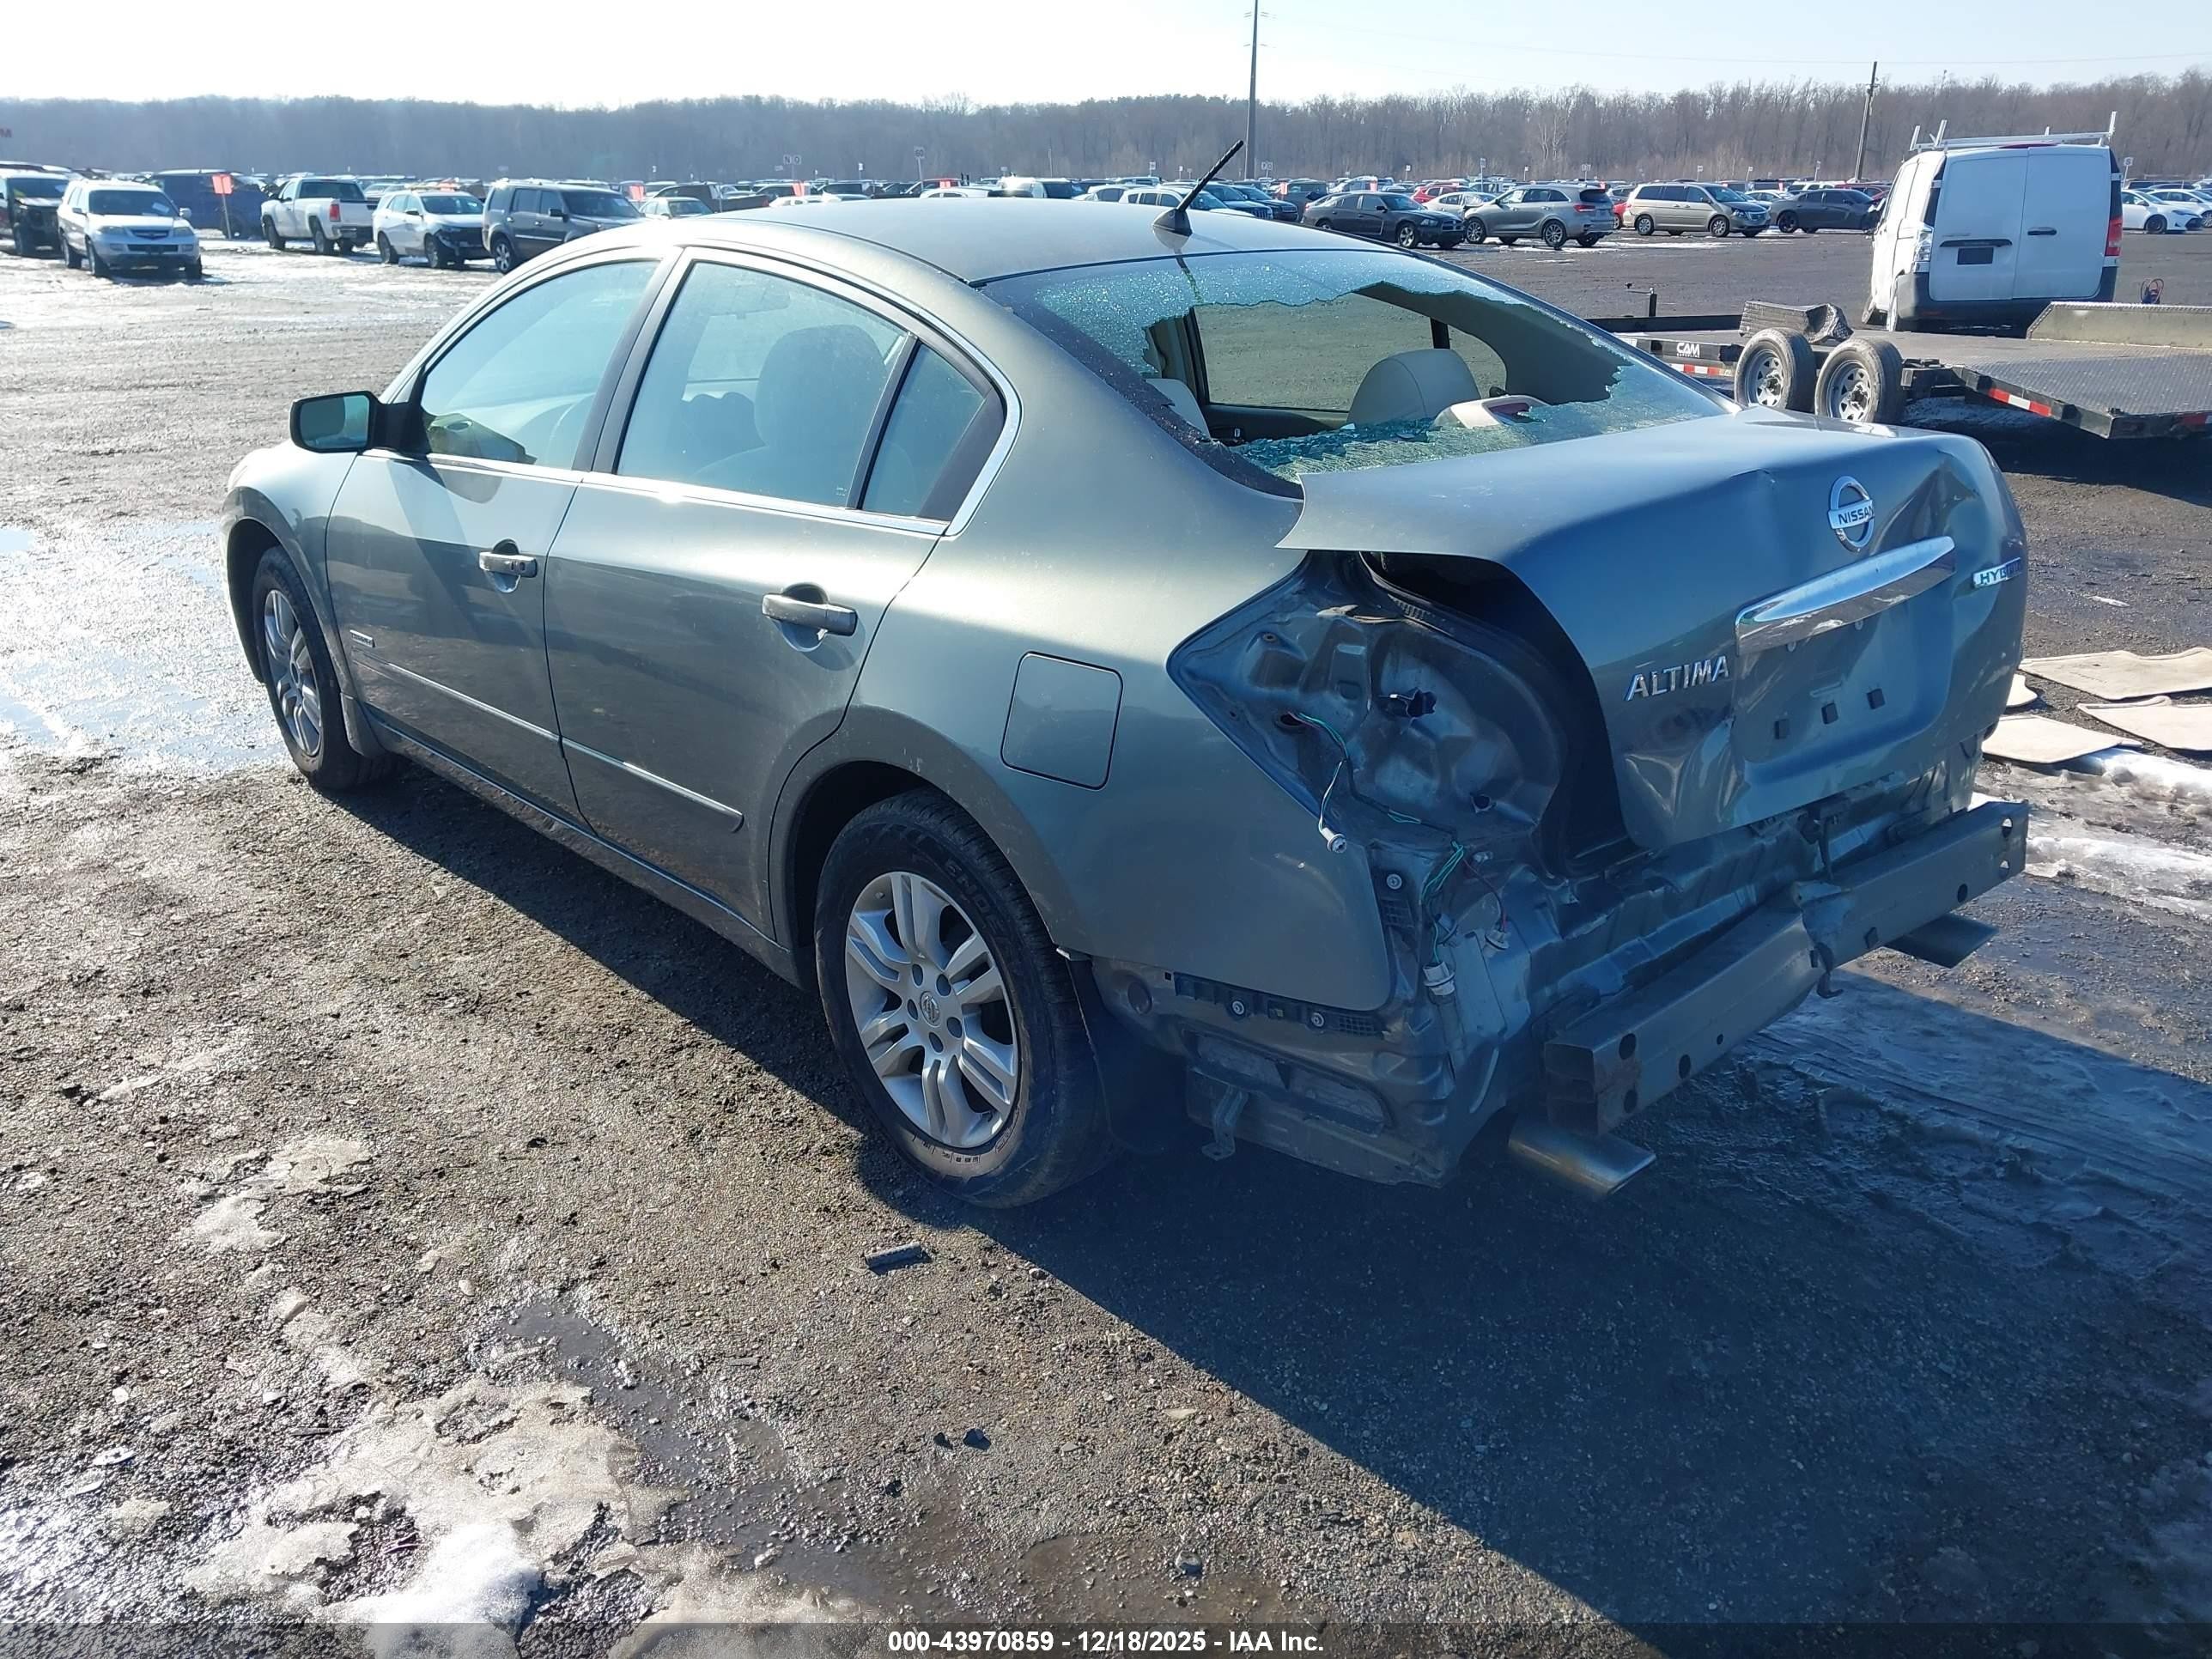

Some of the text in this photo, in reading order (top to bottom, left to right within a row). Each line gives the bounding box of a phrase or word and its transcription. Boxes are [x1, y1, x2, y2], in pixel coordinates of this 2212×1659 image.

[1676, 342, 1700, 358] CAM
[1838, 505, 1875, 526] NISSAN
[1625, 655, 1729, 701] ALTIMA
